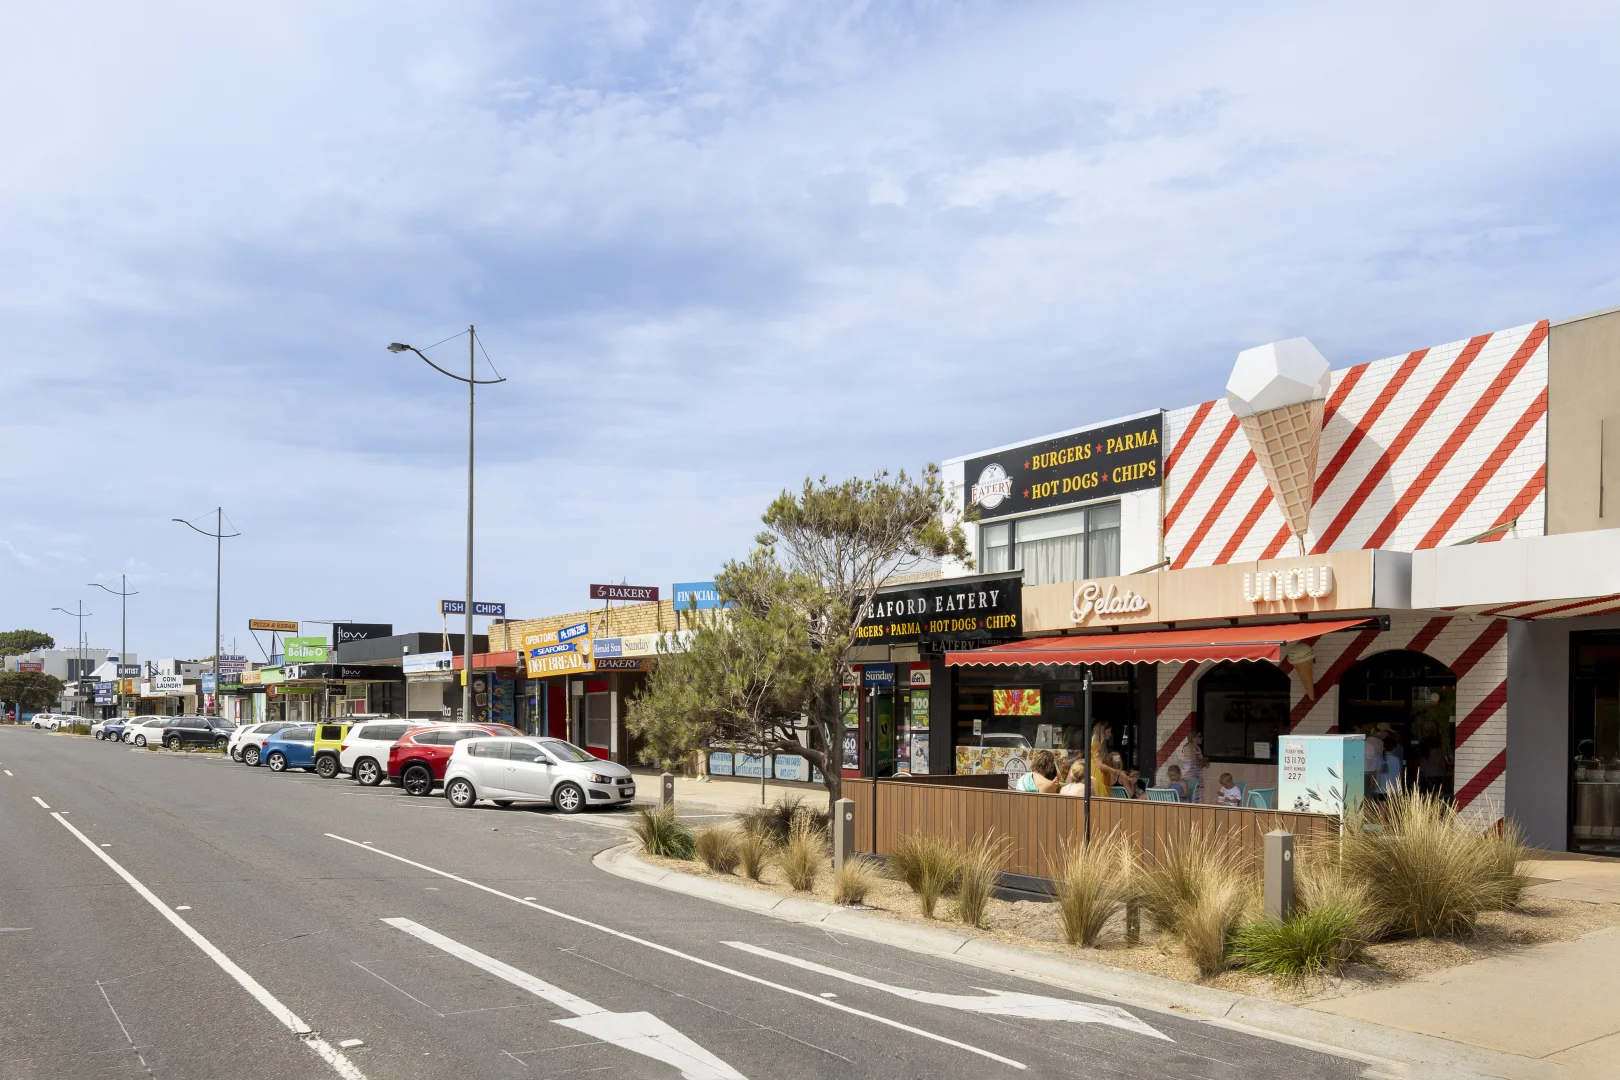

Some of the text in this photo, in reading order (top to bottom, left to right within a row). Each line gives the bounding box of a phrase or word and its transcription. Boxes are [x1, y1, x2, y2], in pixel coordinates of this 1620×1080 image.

[1032, 428, 1158, 471] BURGERS PARMA
[1032, 460, 1157, 499] HOT DOGS CHIPS
[971, 480, 1013, 504] EATERY
[608, 587, 652, 599] BAKERY
[677, 590, 715, 602] FINNCIAL
[444, 602, 502, 614] FISH CHIPS
[935, 590, 1000, 612] EATERY
[1070, 581, 1150, 623] Gelato
[891, 622, 921, 636] PARMA
[929, 619, 949, 633] HOT
[951, 617, 977, 631] DOGS
[986, 614, 1017, 629] CHIPS
[338, 626, 368, 643] flow
[525, 631, 557, 646] OPEN 7 DAYS
[537, 644, 569, 655] SEAFORD
[594, 641, 622, 653] Herald Sun
[624, 638, 650, 652] Sunday
[932, 640, 975, 652] EATERY
[527, 658, 547, 674] HOT
[548, 653, 582, 671] BREAD
[598, 659, 638, 668] BAKERY
[865, 670, 892, 682] Sunday
